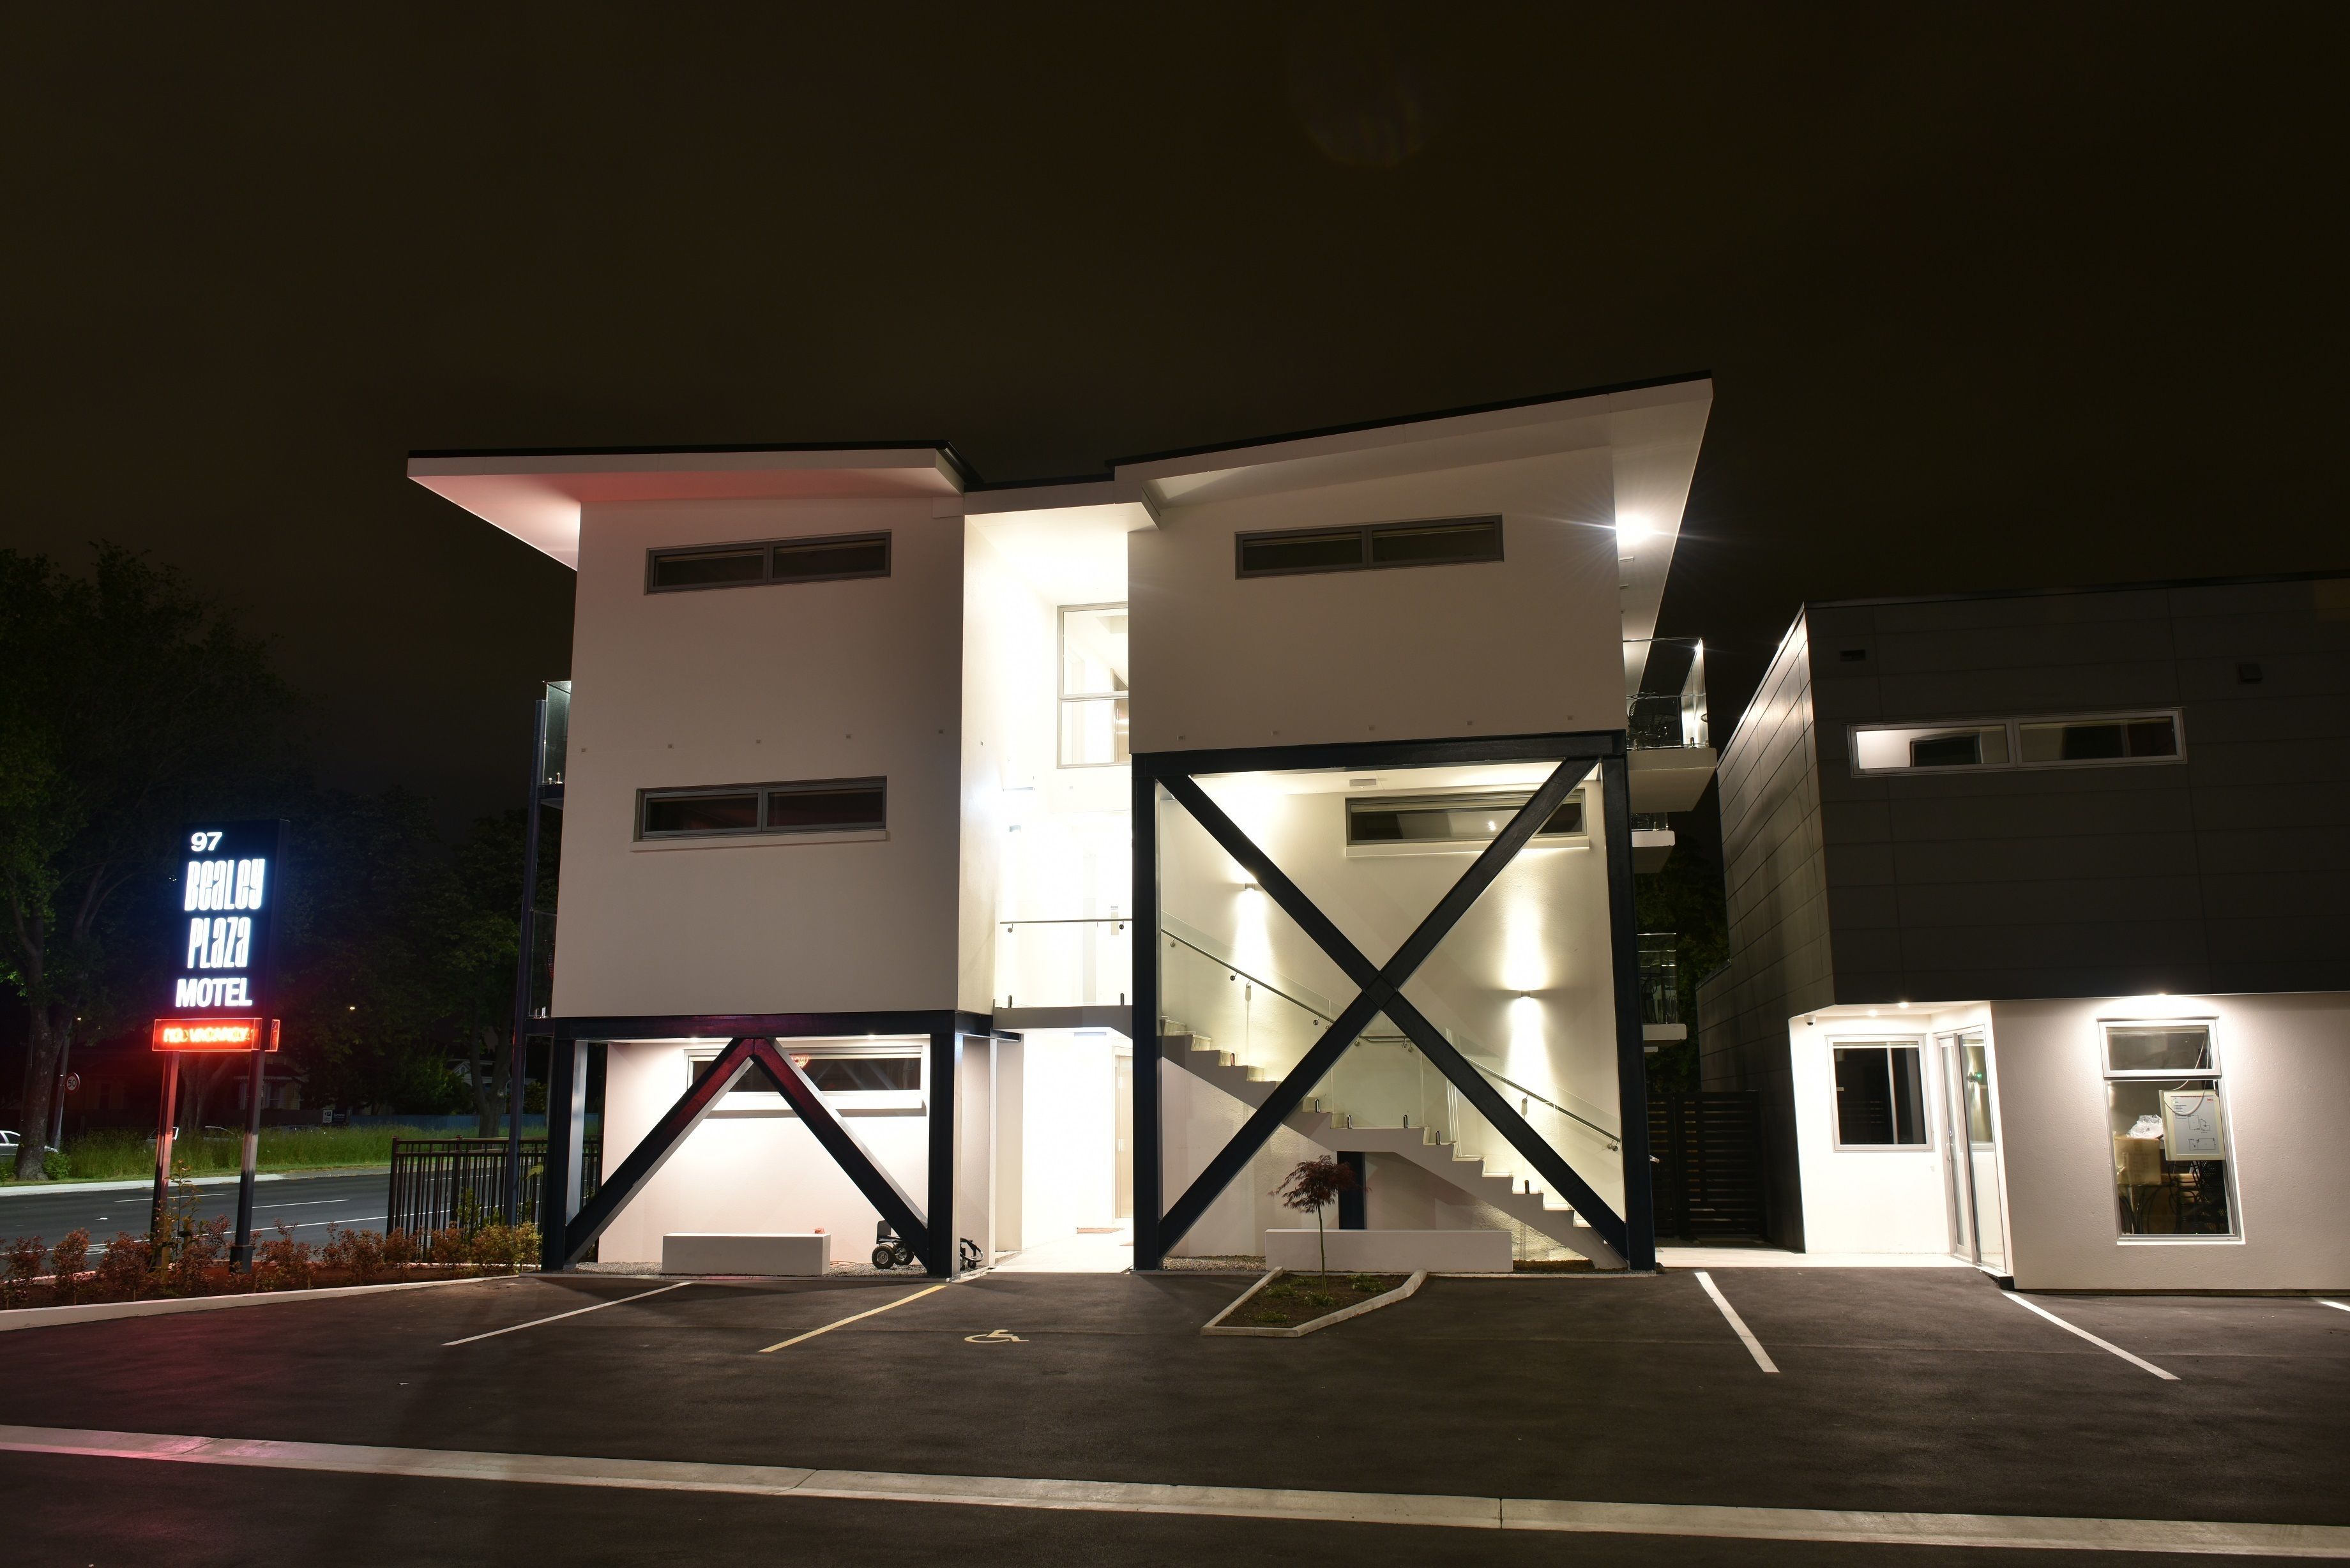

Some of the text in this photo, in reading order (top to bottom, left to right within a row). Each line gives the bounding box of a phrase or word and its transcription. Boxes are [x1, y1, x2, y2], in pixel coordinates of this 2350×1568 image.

[190, 831, 223, 852] 97
[175, 977, 253, 1007] MOTEL
[68, 1079, 76, 1087] 50
